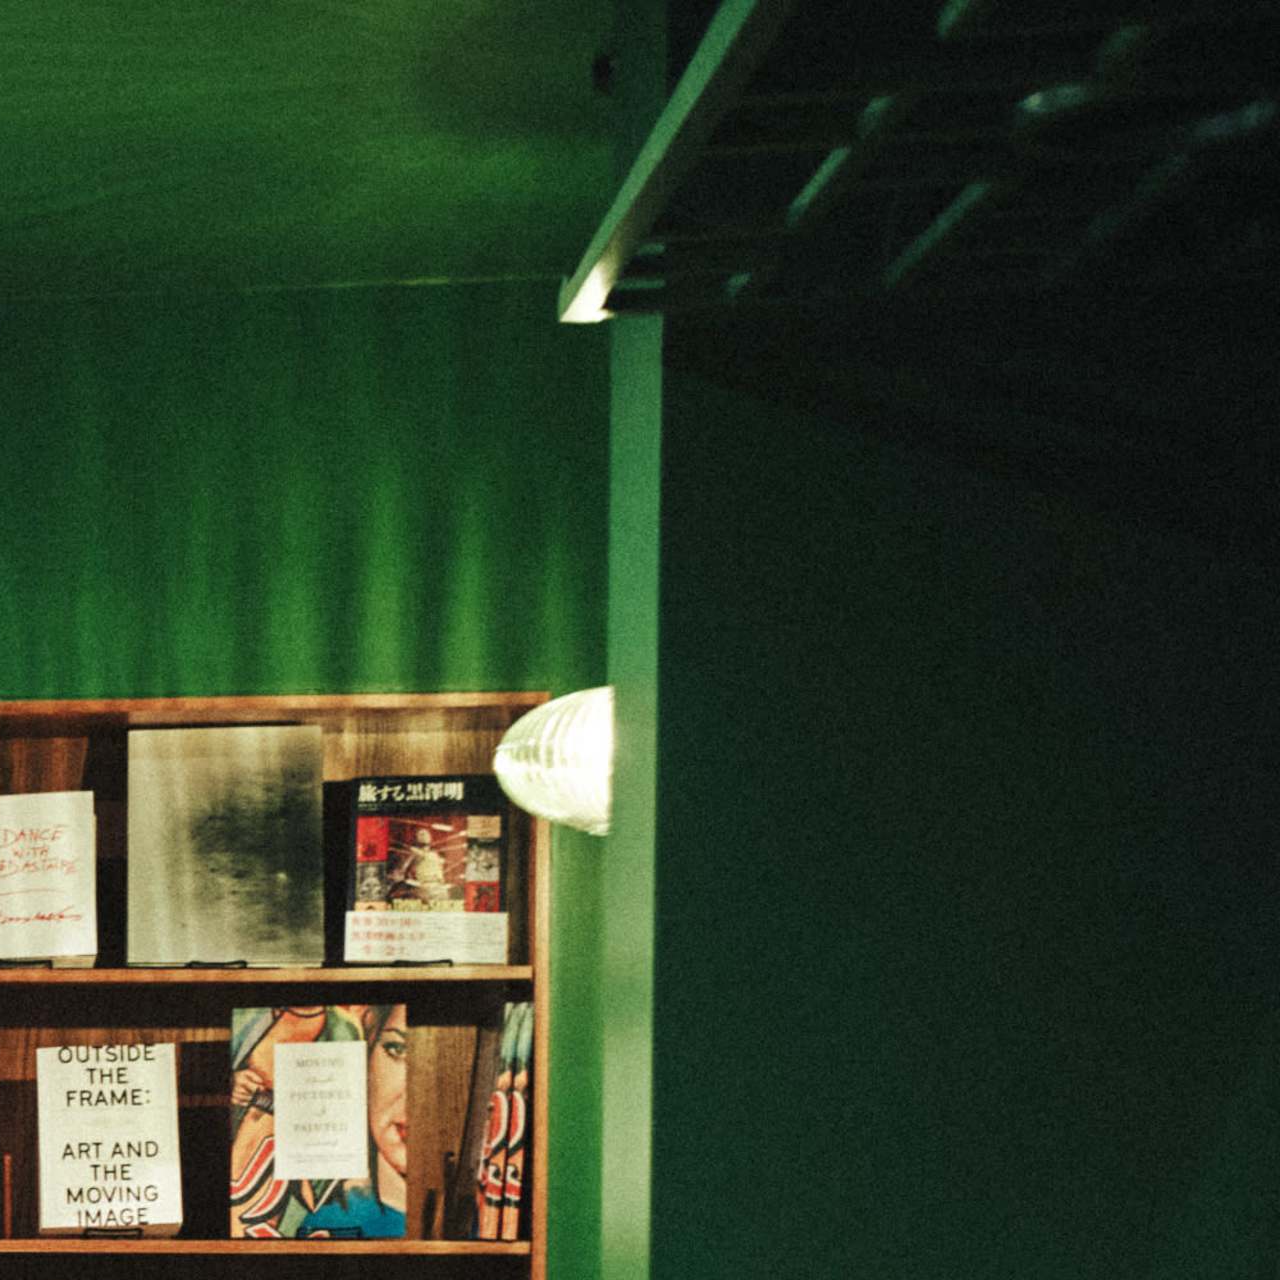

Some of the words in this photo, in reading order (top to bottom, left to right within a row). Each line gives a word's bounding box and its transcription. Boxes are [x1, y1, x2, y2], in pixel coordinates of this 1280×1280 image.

[58, 1045, 156, 1064] OUTSIDE
[86, 1067, 129, 1085] THE
[66, 1088, 151, 1107] FRAME:
[61, 1142, 102, 1160] ART
[111, 1140, 159, 1159] AND
[90, 1163, 133, 1182] THE
[66, 1184, 158, 1204] MOVING
[77, 1207, 149, 1227] IMAGE
